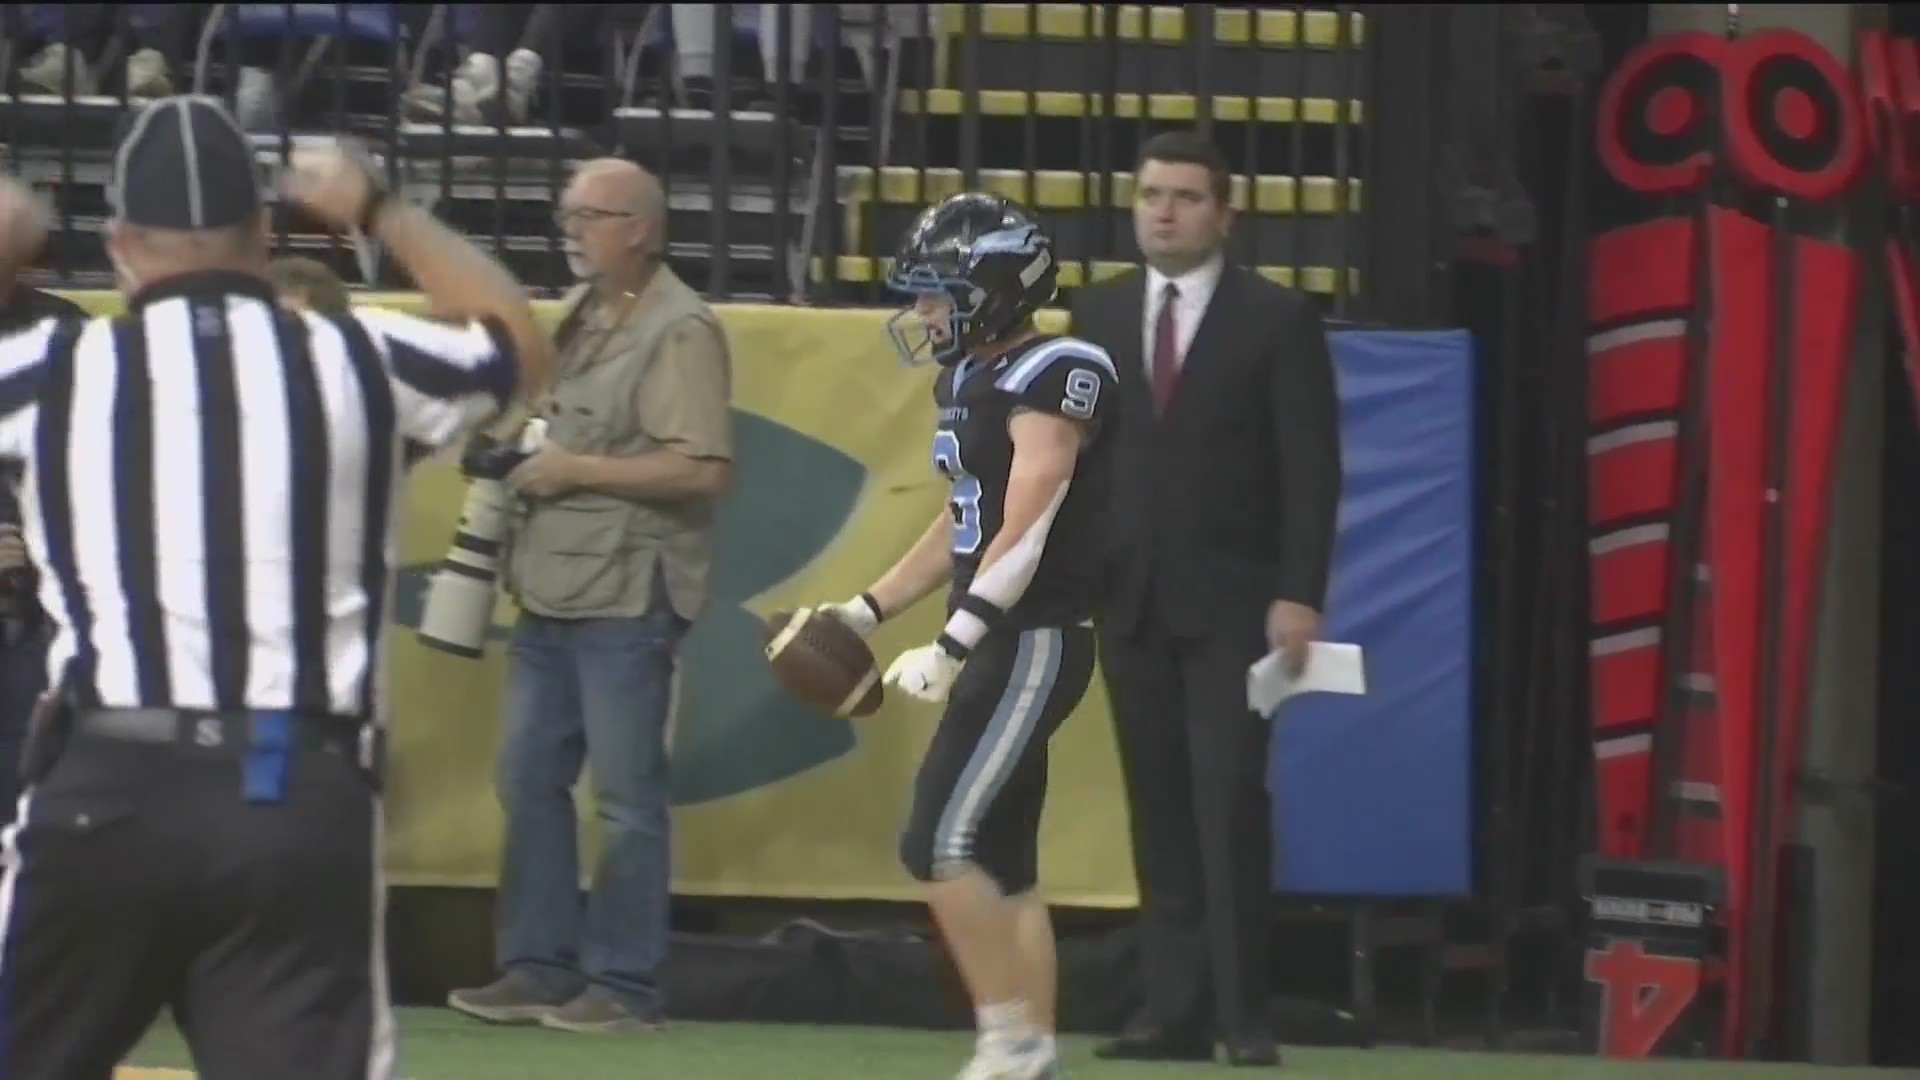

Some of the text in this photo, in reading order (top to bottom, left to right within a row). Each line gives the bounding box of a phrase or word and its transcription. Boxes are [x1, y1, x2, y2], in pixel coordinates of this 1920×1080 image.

[1061, 368, 1101, 420] 9
[931, 430, 983, 554] 9
[1584, 940, 1701, 1061] 4
